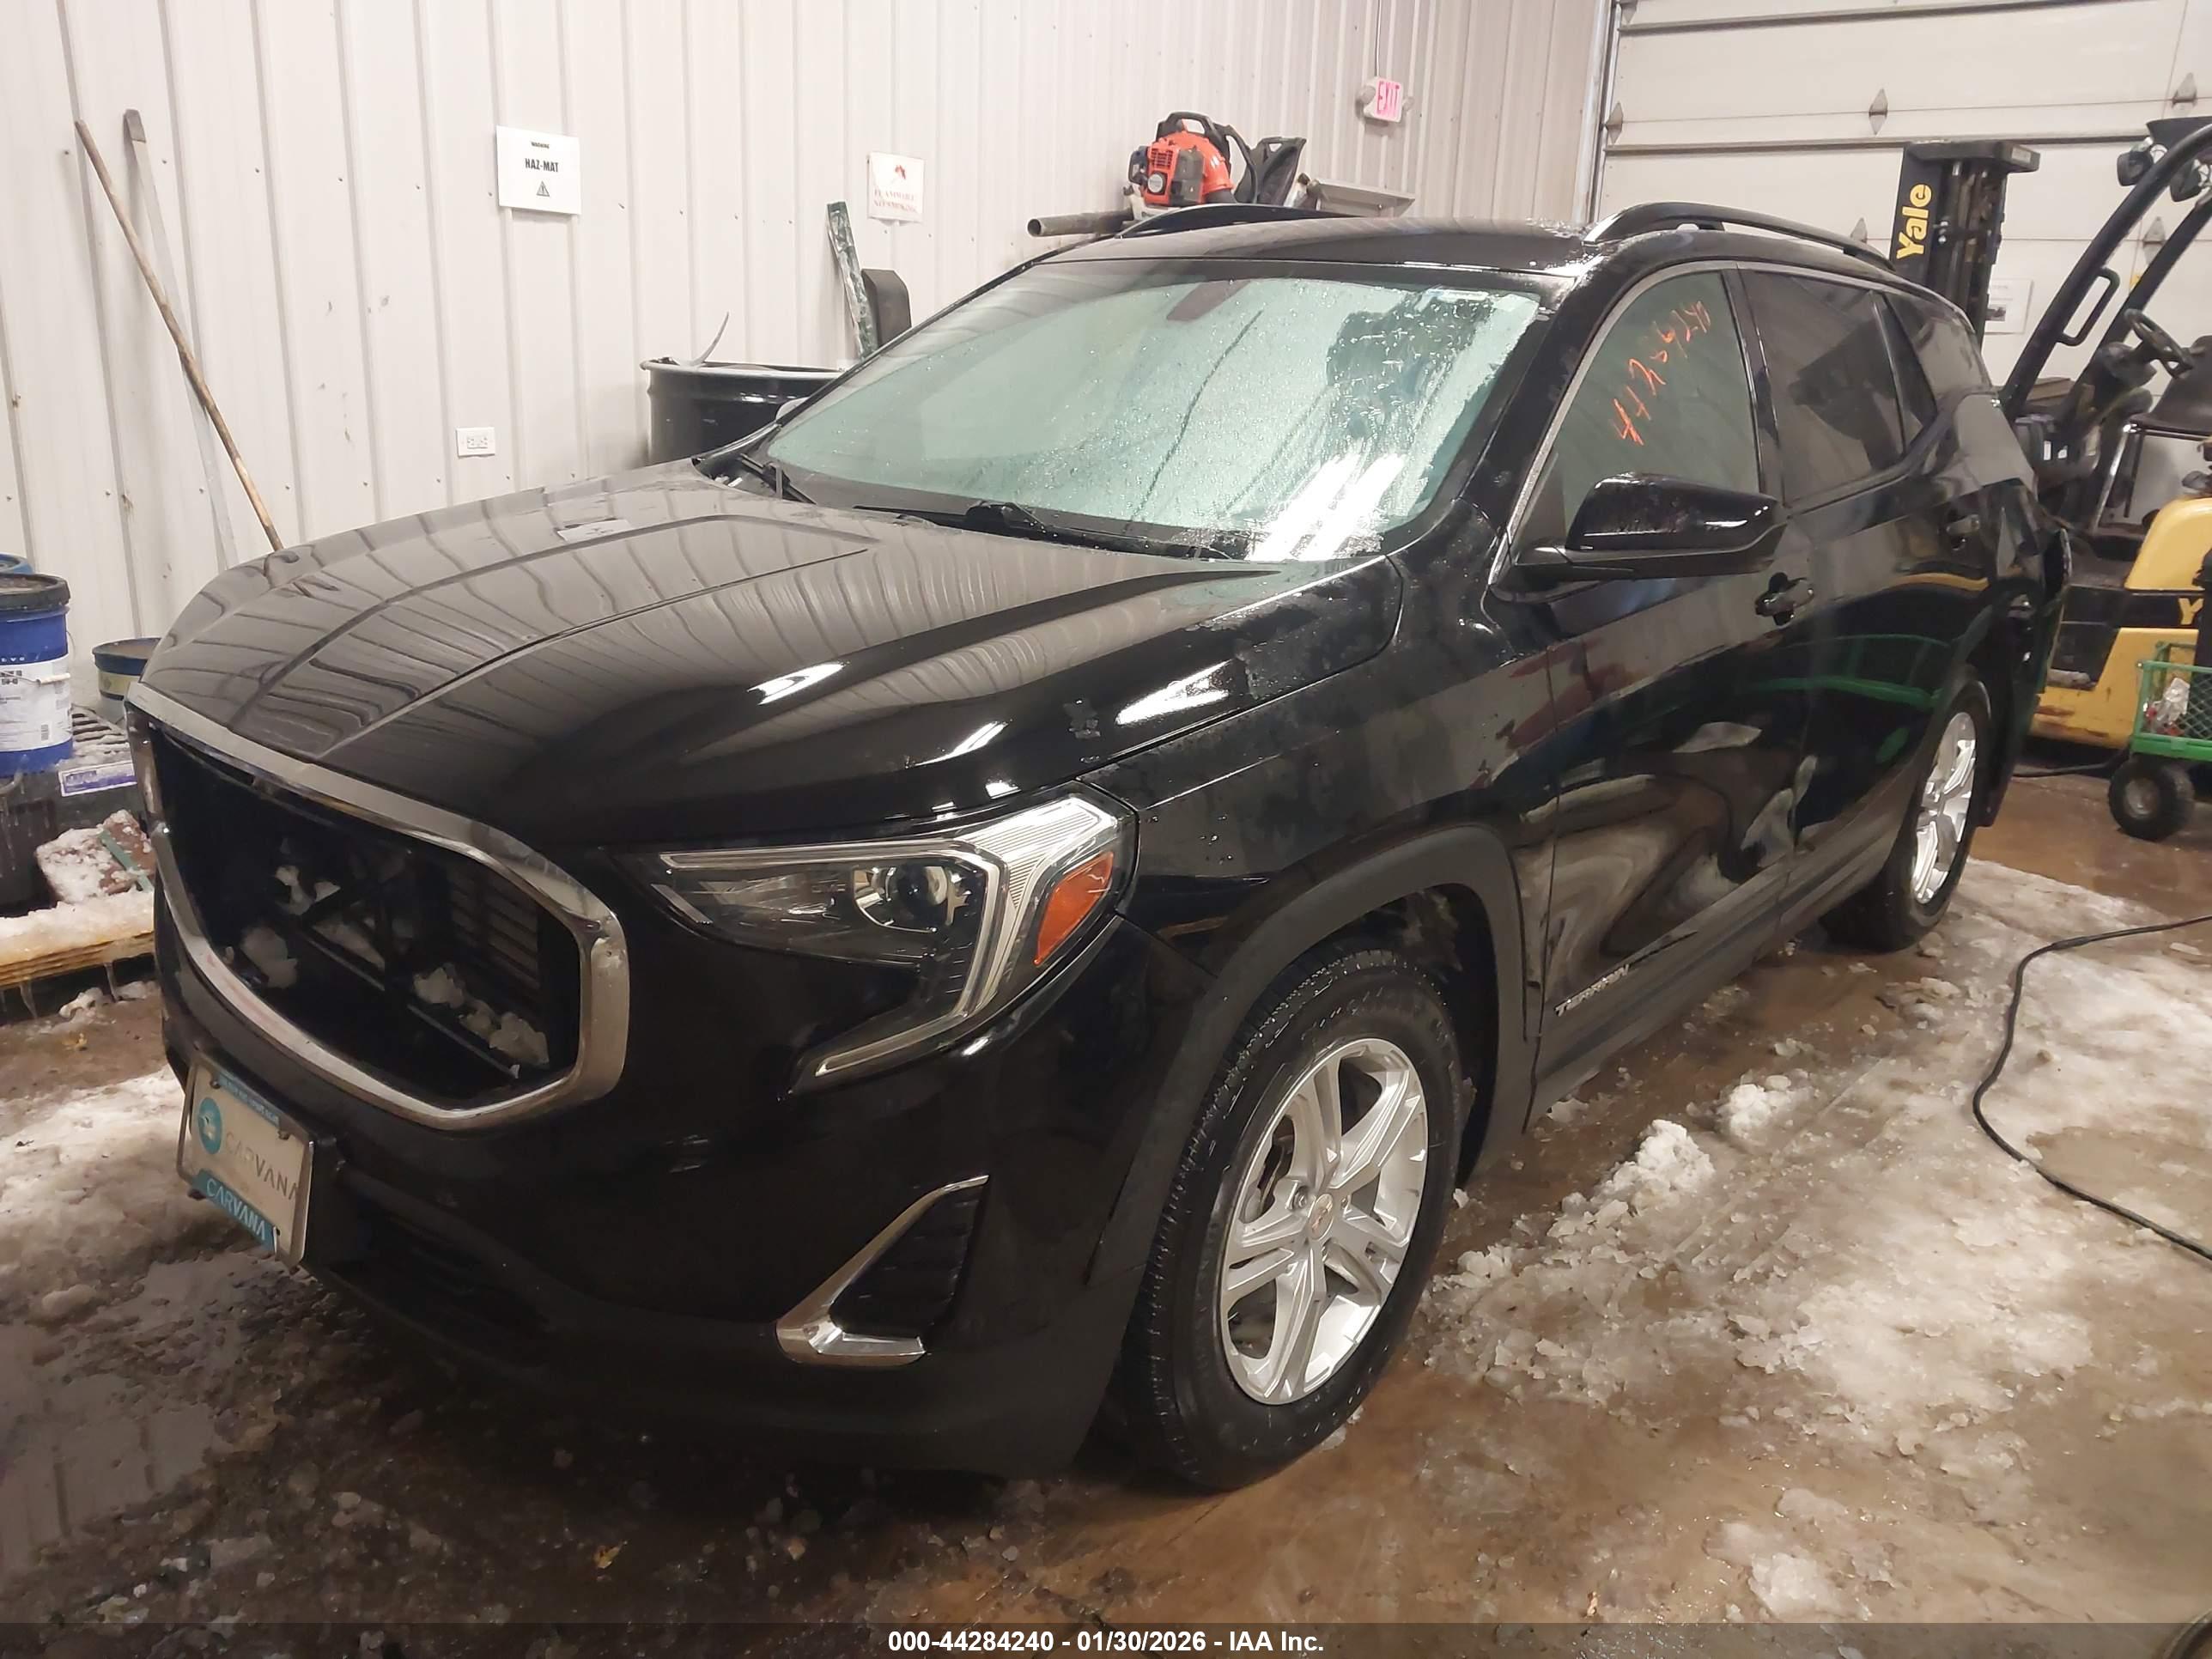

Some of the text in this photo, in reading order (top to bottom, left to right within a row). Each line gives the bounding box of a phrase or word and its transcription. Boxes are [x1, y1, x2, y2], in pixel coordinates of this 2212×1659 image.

[1376, 80, 1400, 116] EXIT
[525, 157, 559, 173] HAZ-MAT
[1896, 184, 1932, 259] Yale
[206, 1177, 266, 1242] CARVANA
